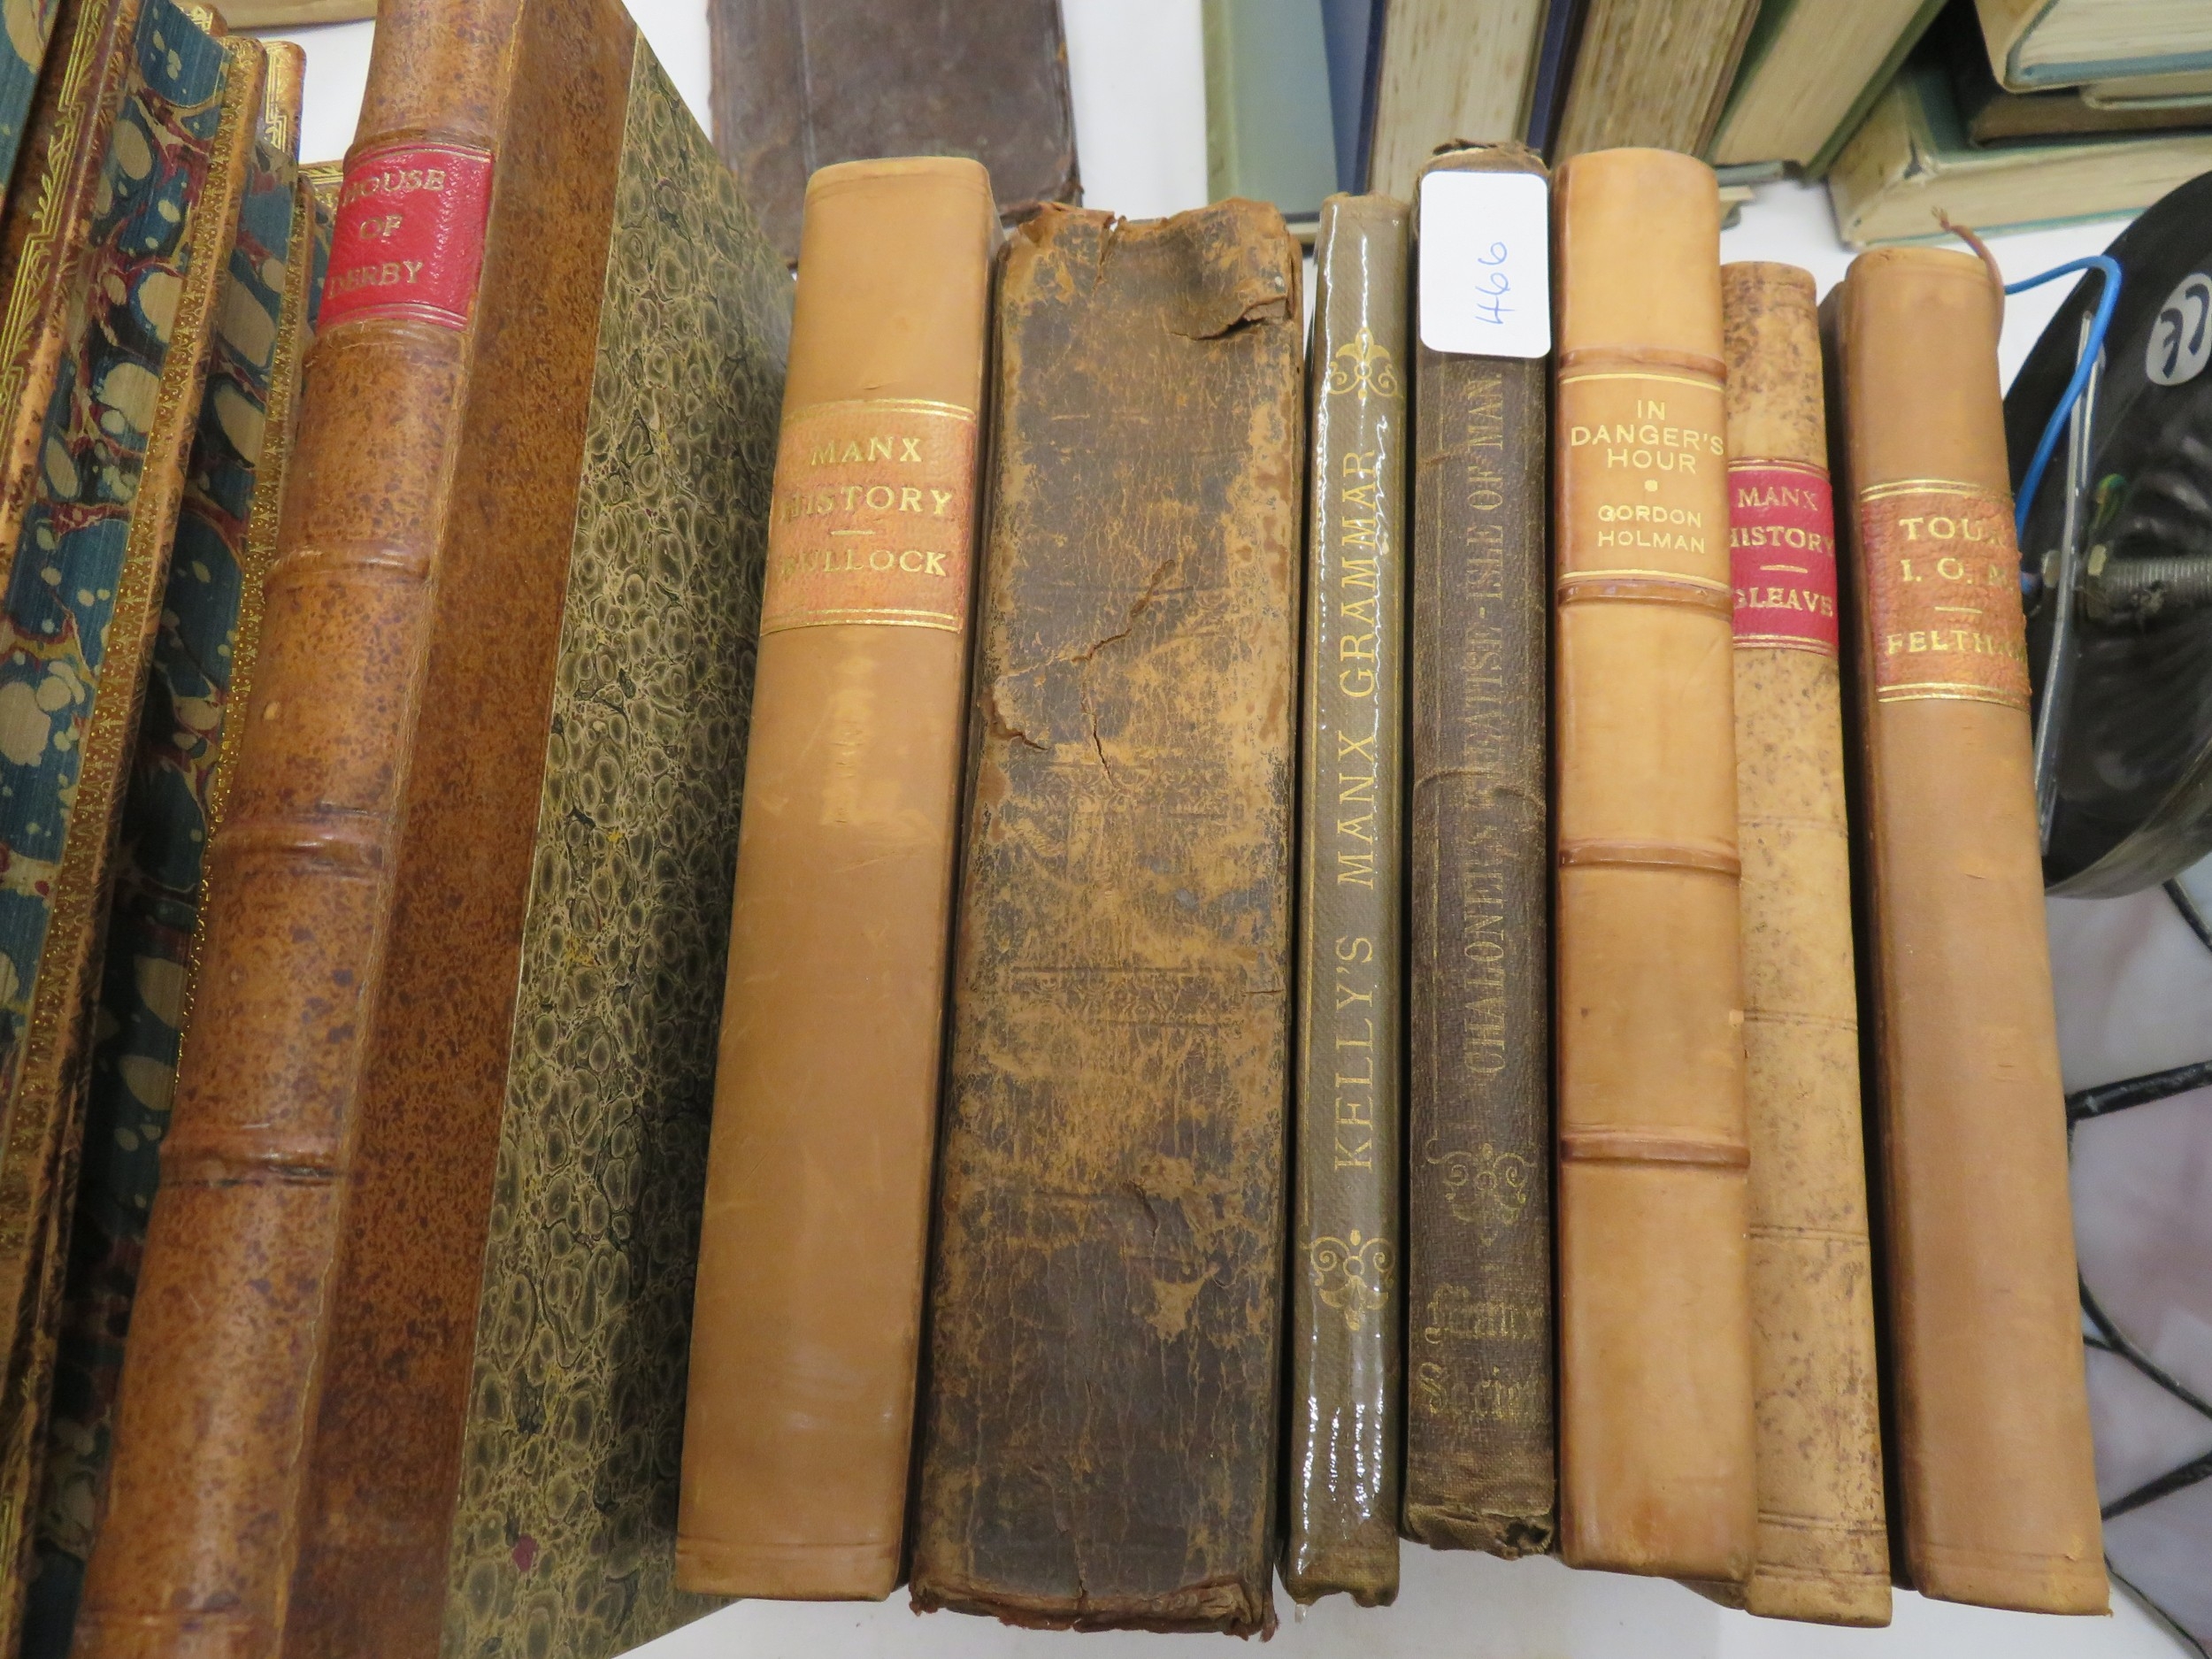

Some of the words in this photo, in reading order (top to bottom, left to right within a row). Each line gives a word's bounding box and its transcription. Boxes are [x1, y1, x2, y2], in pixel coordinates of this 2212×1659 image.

[342, 169, 446, 207] HOUSE
[360, 214, 403, 239] OF
[327, 260, 424, 299] DERBY
[1475, 242, 1515, 324] 466
[1636, 399, 1666, 421] IN
[810, 436, 923, 466] MANX
[1570, 424, 1725, 457] DANGER'S
[1606, 448, 1697, 475] HOUR
[780, 485, 954, 525] HISTORY
[1467, 466, 1503, 511] OF
[1737, 487, 1819, 511] MANX
[1597, 504, 1702, 528] GORDON
[1597, 530, 1706, 555] HOLMAN
[781, 549, 947, 578] BULLOCK
[1339, 449, 1378, 698] GRAMMAR
[1465, 525, 1503, 600] ISLE
[1900, 558, 1924, 583] I.
[1936, 557, 1974, 586] O.
[1336, 730, 1377, 891] MANX
[1334, 934, 1375, 1174] KELLY'S
